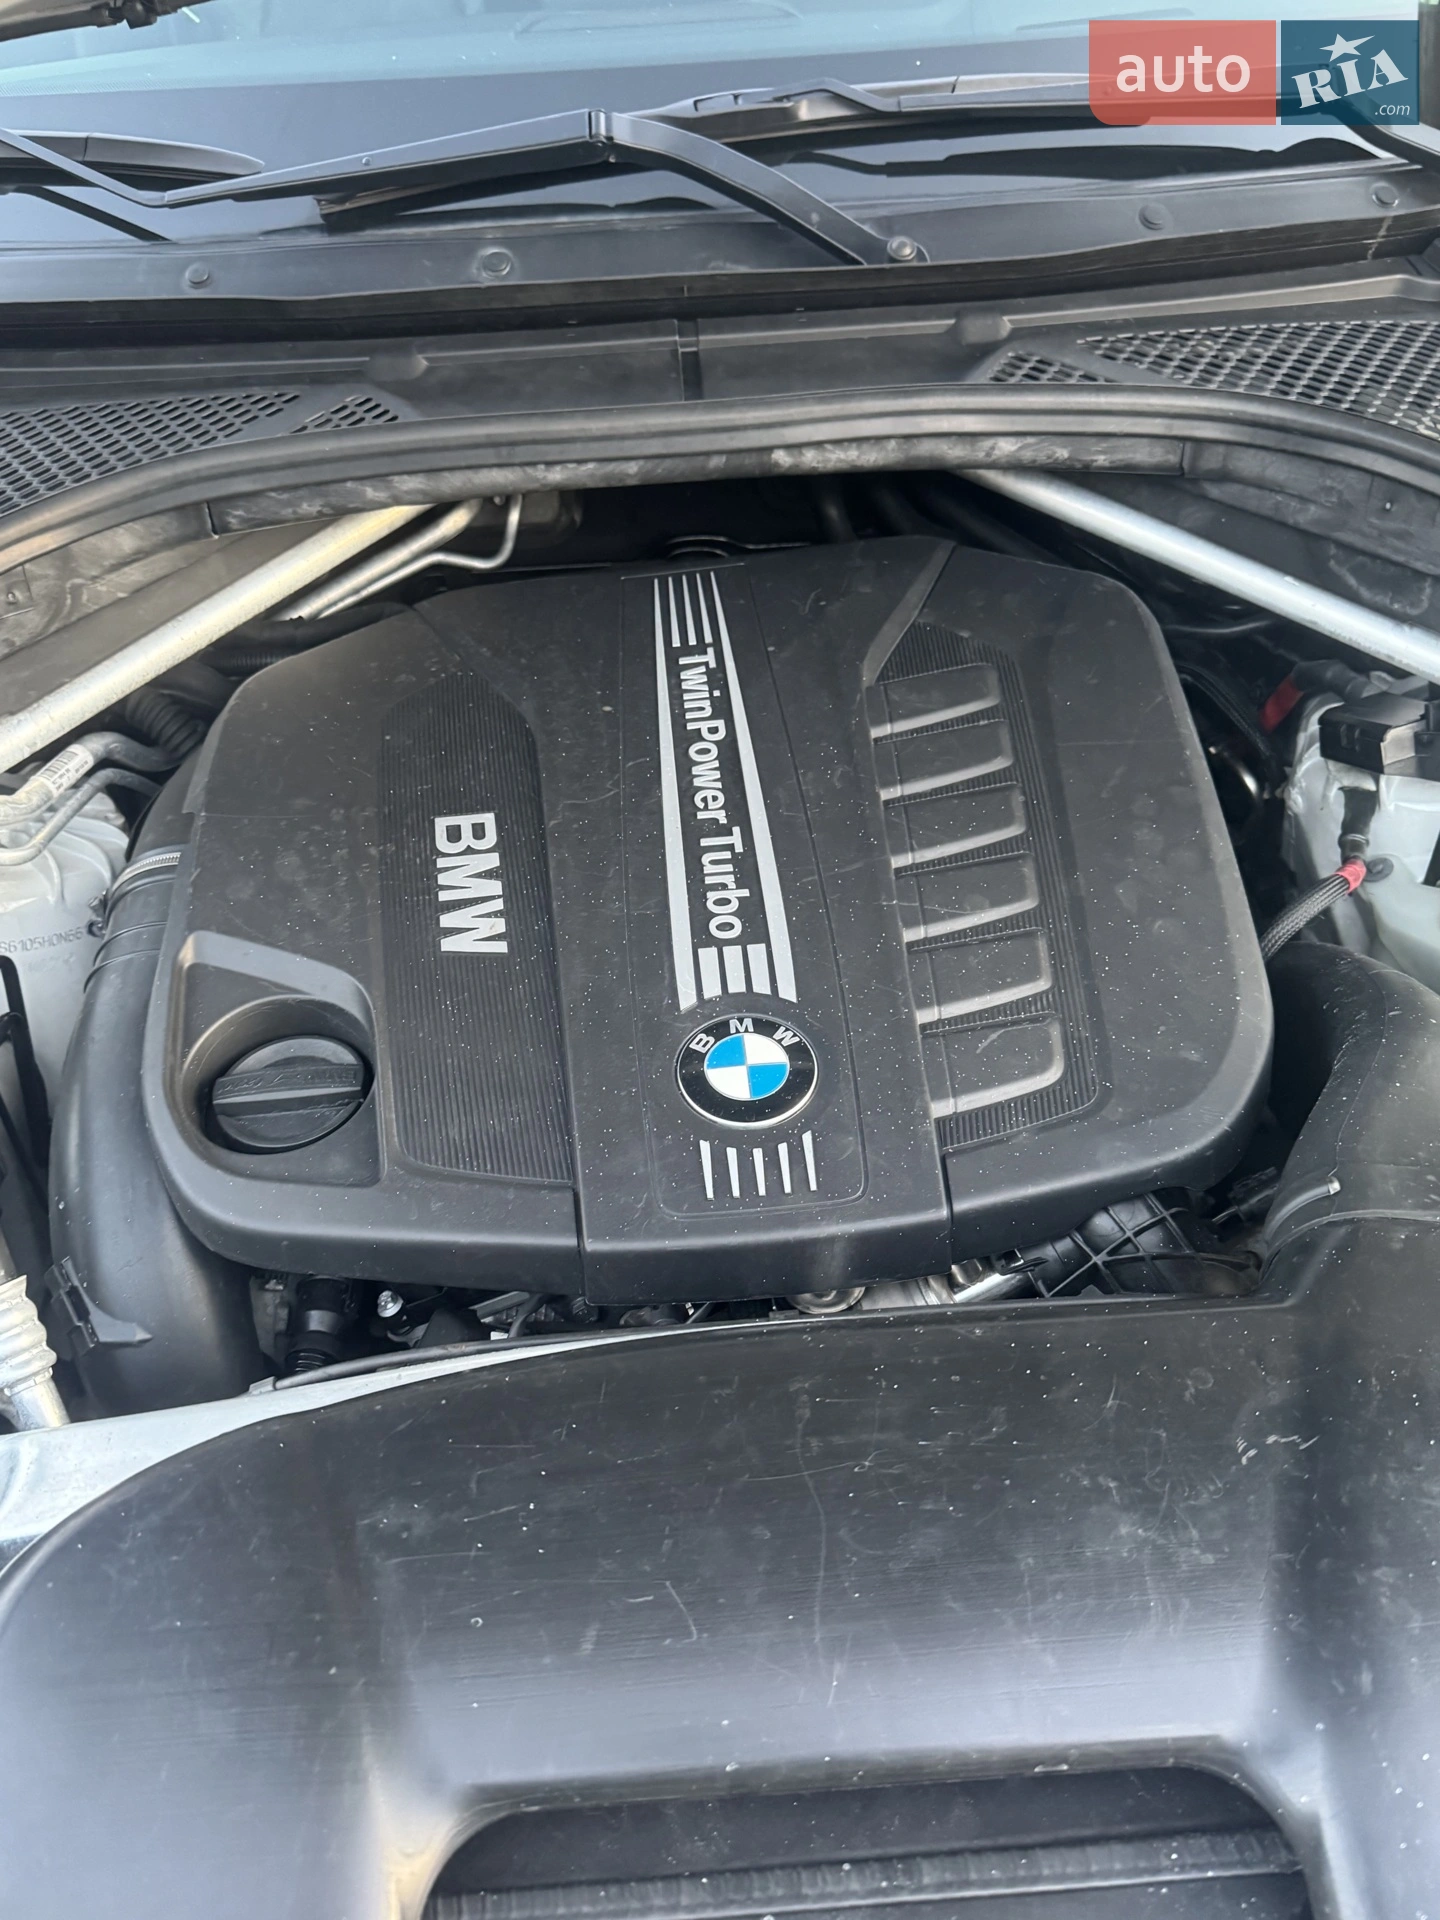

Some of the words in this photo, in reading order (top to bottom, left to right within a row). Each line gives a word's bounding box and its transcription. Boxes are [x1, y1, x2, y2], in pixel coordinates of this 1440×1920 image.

[677, 646, 728, 824] TwinPower
[434, 812, 508, 953] BMW
[700, 825, 750, 939] Turbo
[689, 1018, 800, 1053] BMW
